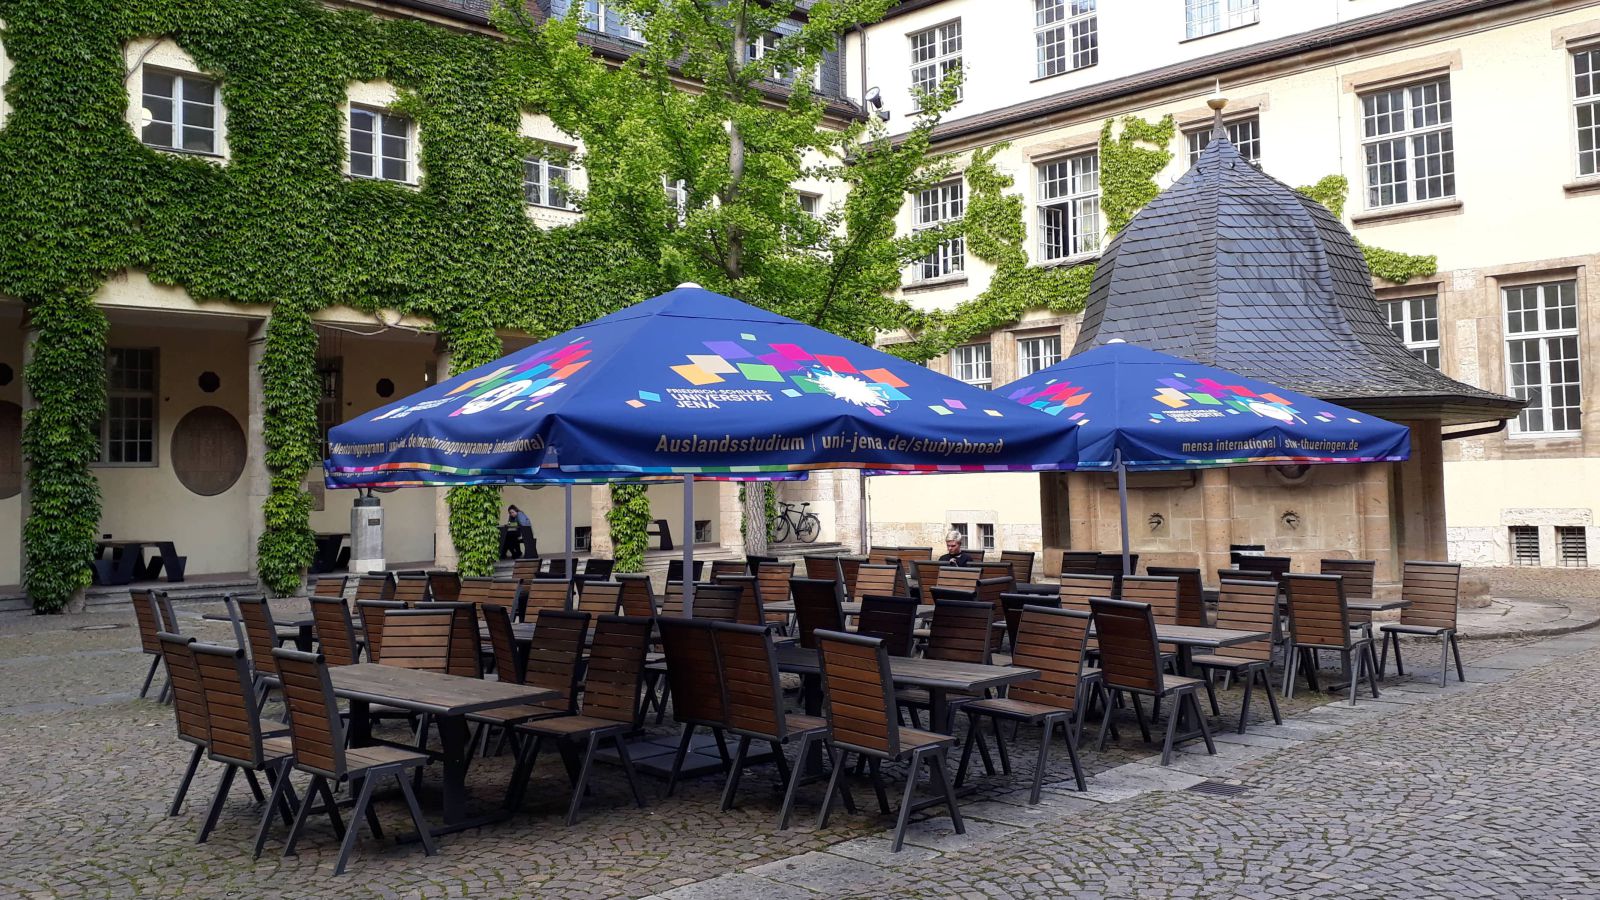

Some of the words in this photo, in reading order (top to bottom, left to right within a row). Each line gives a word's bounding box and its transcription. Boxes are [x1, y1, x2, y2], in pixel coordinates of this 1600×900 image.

[675, 400, 720, 409] JENA
[655, 434, 805, 452] Auslandsstudium
[822, 431, 1004, 457] uni-jena.de/studyabroad
[1182, 442, 1213, 452] mensa
[1216, 436, 1276, 451] international
